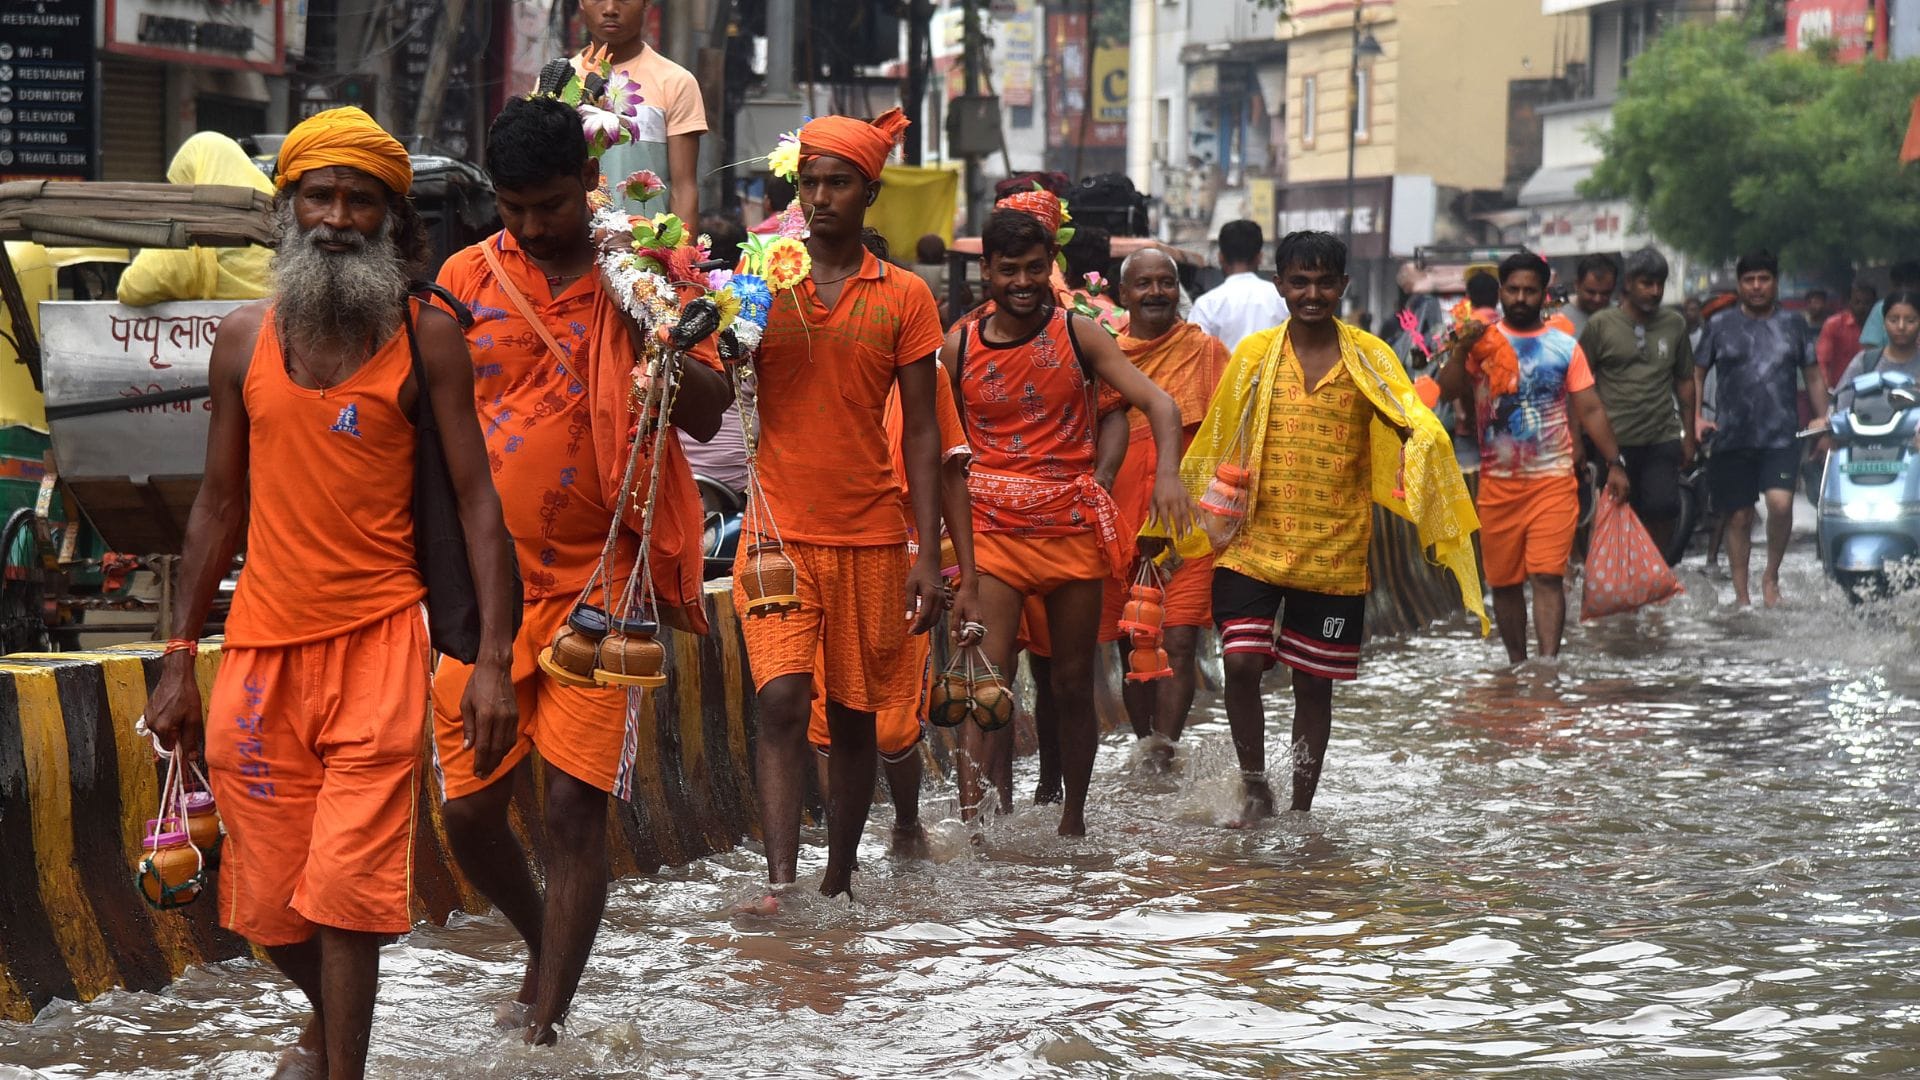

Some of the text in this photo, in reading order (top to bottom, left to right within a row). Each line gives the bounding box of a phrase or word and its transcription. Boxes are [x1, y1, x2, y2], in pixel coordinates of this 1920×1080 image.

[3, 15, 80, 26] RESTAURANT
[19, 69, 85, 80] RESTAURANT
[19, 90, 83, 101] DORMITORY
[19, 111, 76, 122] ELEVATOR
[19, 132, 68, 144] PARKING
[19, 152, 87, 165] TRAVEL DESK
[1322, 616, 1345, 638] 07
